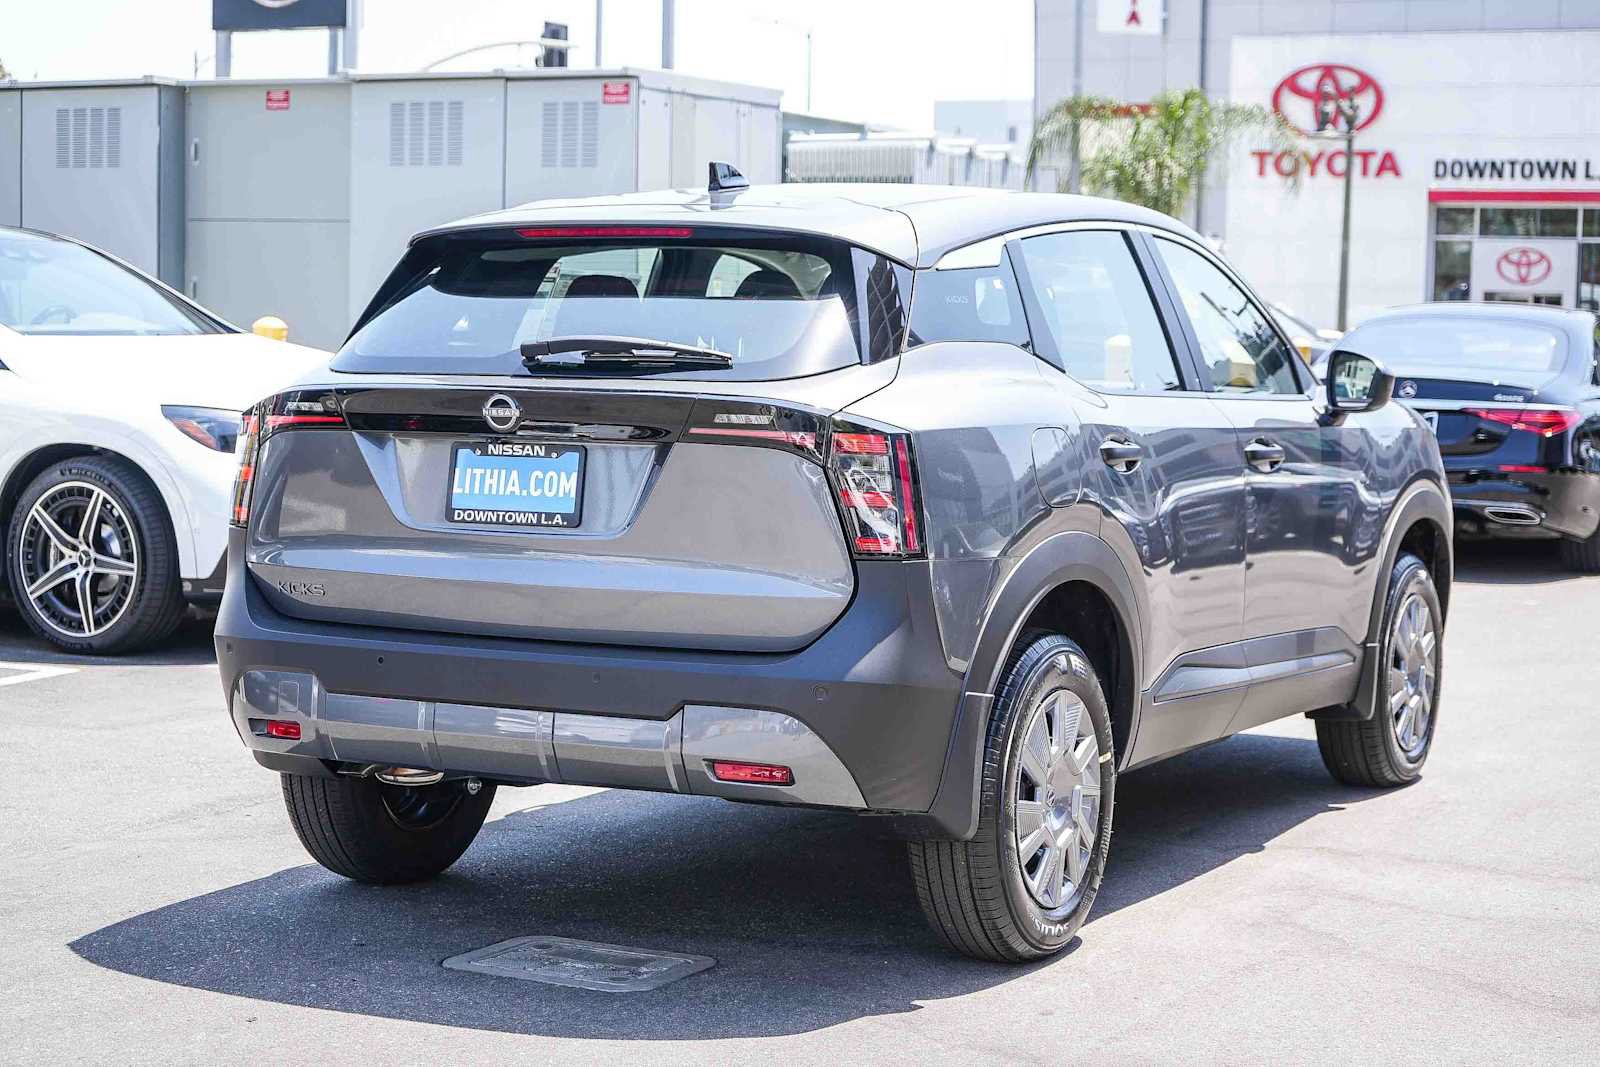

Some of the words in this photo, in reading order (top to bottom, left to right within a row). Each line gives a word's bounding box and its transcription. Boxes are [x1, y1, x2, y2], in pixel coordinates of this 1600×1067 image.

[1250, 151, 1402, 177] TOYOTA
[1435, 160, 1576, 179] DOWNTOWN
[1585, 160, 1600, 180] L.
[482, 407, 520, 417] NISSAN
[487, 443, 545, 457] NISSAN
[453, 467, 578, 498] LITHIA.COM
[454, 509, 537, 525] DOWNTOWN
[541, 513, 568, 526] L.A.
[278, 580, 326, 596] KICKS
